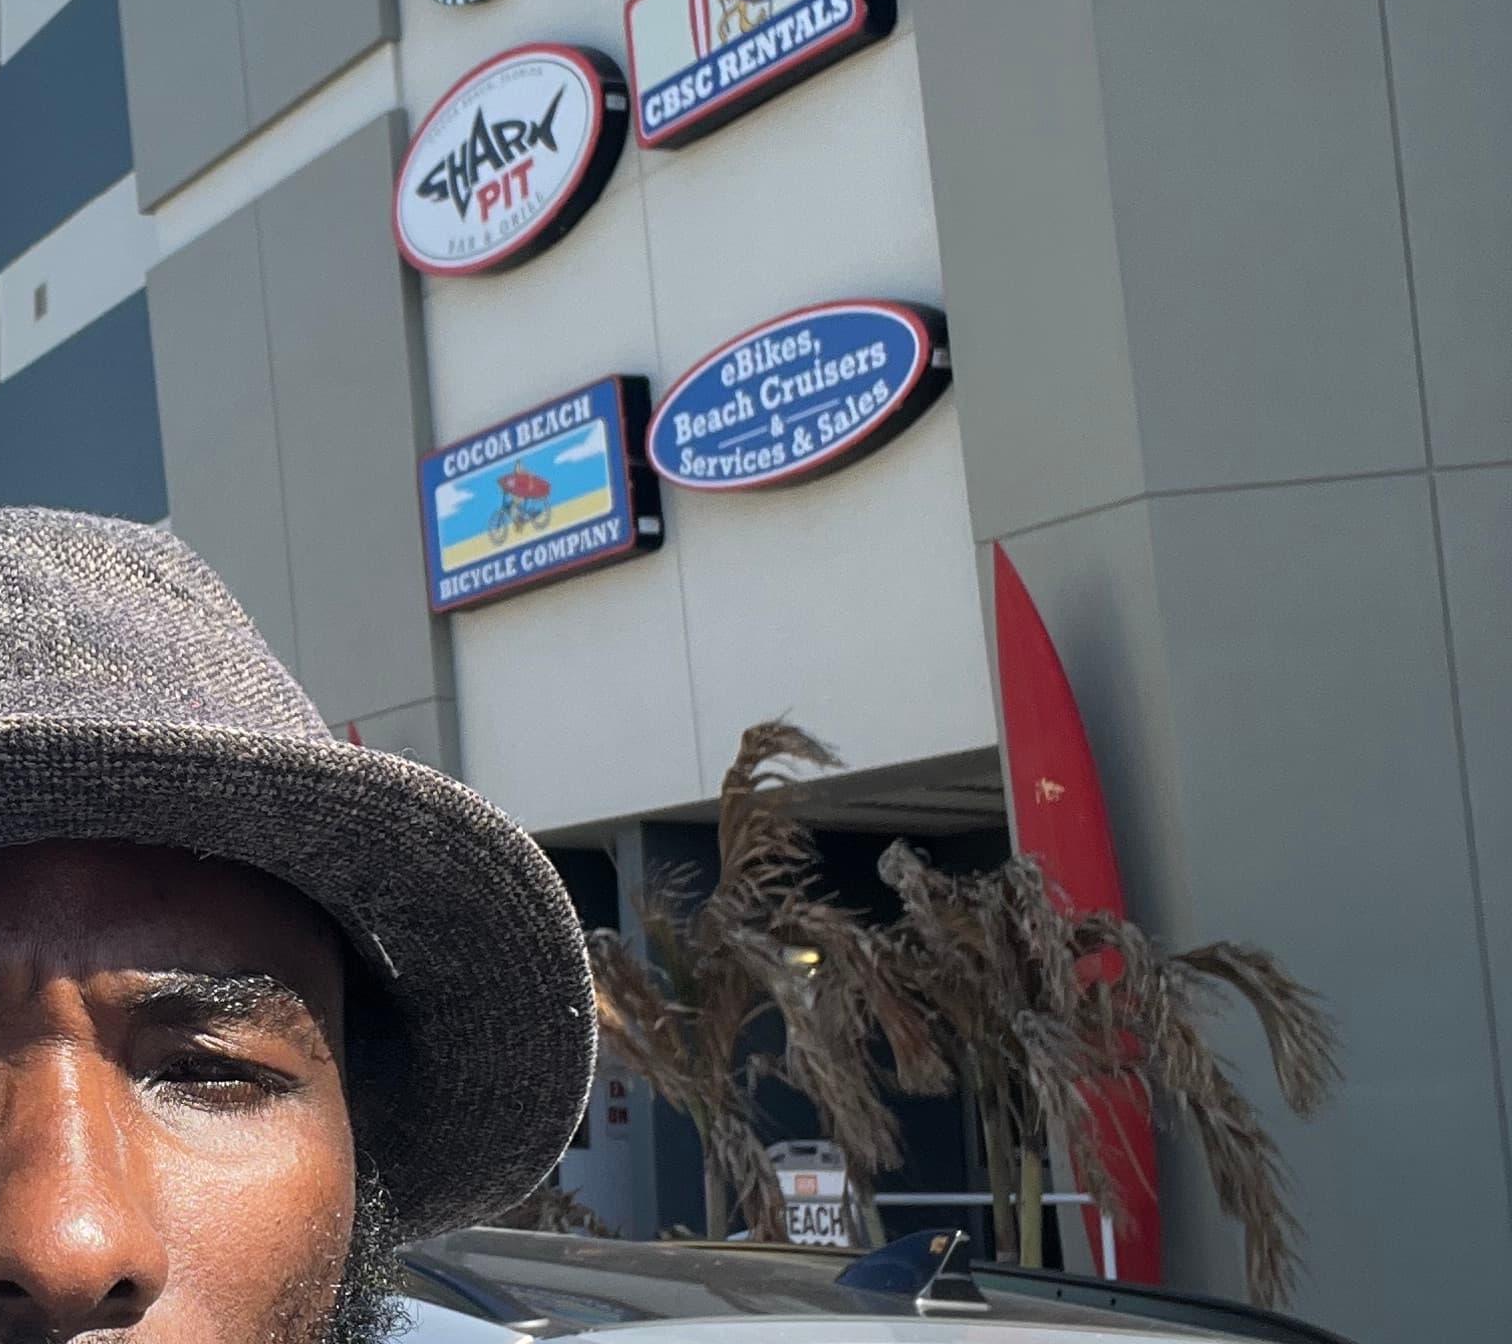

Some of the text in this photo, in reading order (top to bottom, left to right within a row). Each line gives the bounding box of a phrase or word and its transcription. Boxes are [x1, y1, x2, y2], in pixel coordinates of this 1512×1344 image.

[644, 63, 713, 127] CBSC
[415, 82, 567, 222] SHARK
[476, 157, 534, 223] PIT
[673, 341, 887, 446] Beach Cruisers
[721, 329, 822, 387] eBikes,
[443, 394, 592, 478] COCOA BEACH
[679, 378, 889, 477] Services & Sales
[770, 414, 785, 437] &
[439, 517, 621, 601] BICYCLE COMPANY
